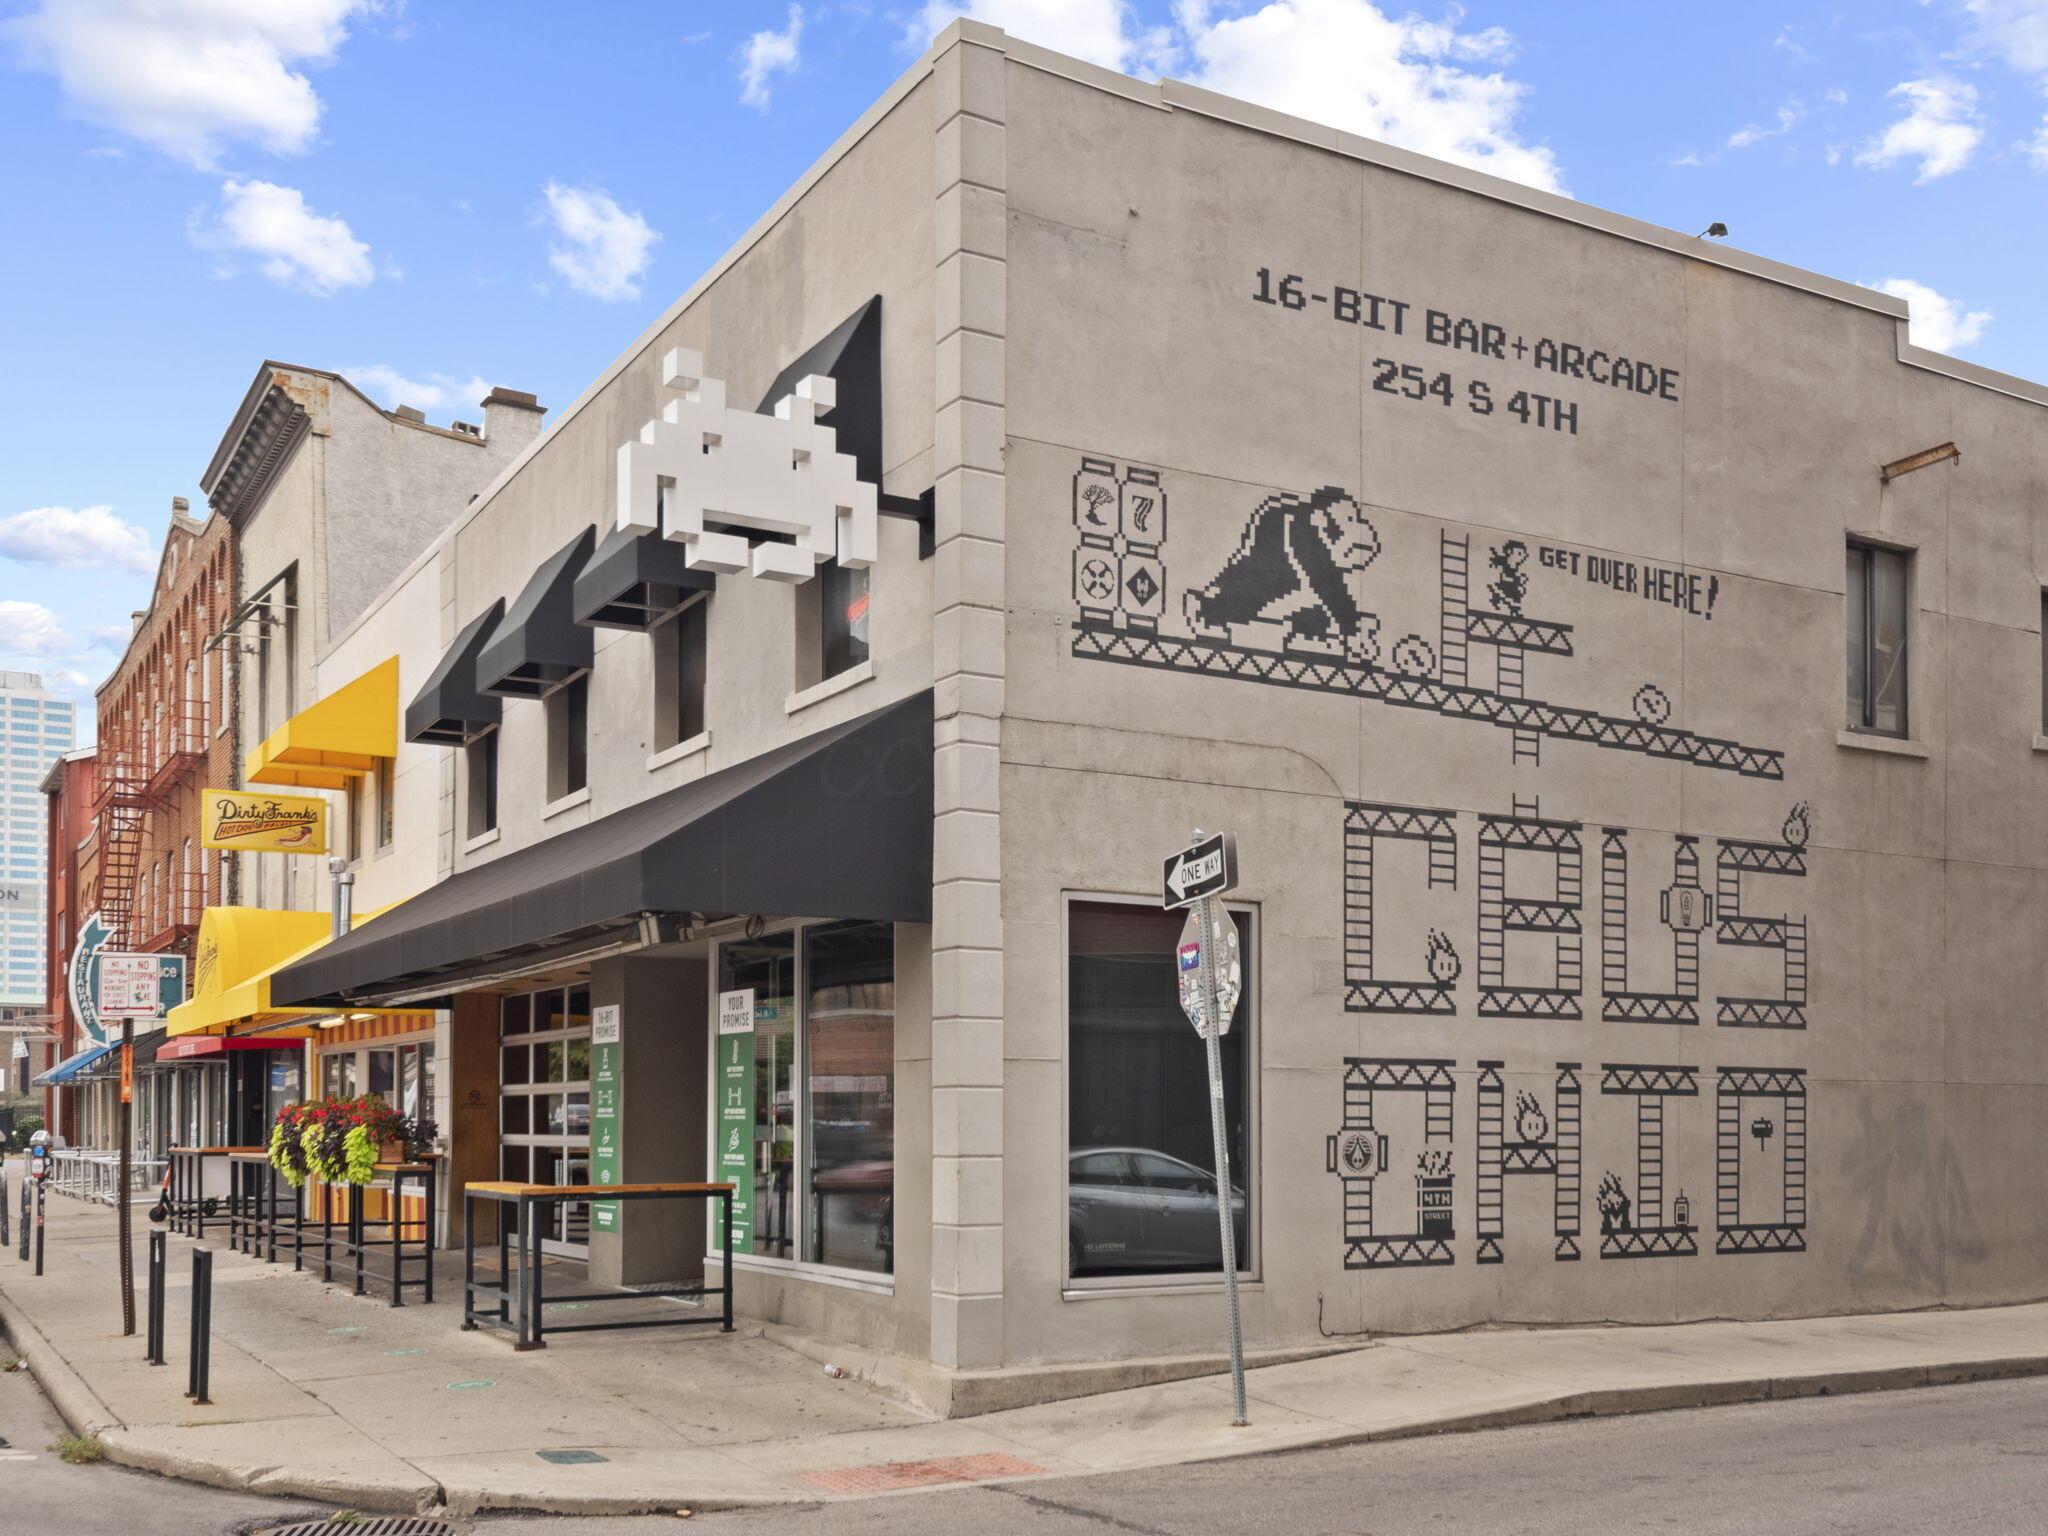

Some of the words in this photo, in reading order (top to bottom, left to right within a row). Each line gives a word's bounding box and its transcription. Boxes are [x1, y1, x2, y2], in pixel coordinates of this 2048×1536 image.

[1252, 267, 1410, 336] 16-BIT
[1425, 308, 1680, 403] BAR+ARCADE
[1372, 357, 1454, 407] 254
[1468, 379, 1494, 416] S
[1507, 390, 1578, 436] 4TH
[1539, 546, 1581, 576] GET
[1586, 555, 1638, 594] OVER
[1643, 565, 1719, 621] HERE!
[216, 799, 264, 828] Dirty
[264, 800, 319, 821] Frank's
[219, 825, 237, 836] HOT
[1181, 864, 1202, 885] ONE
[1204, 852, 1220, 874] WAY
[137, 961, 150, 970] NO
[130, 972, 157, 982] STOPPING
[76, 947, 95, 1024] RESTAURANT
[136, 983, 150, 991] ANY
[727, 995, 744, 1011] YOUR
[722, 1012, 750, 1029] PROMISE
[1424, 1192, 1451, 1205] 4TH
[1424, 1212, 1450, 1221] STREET
